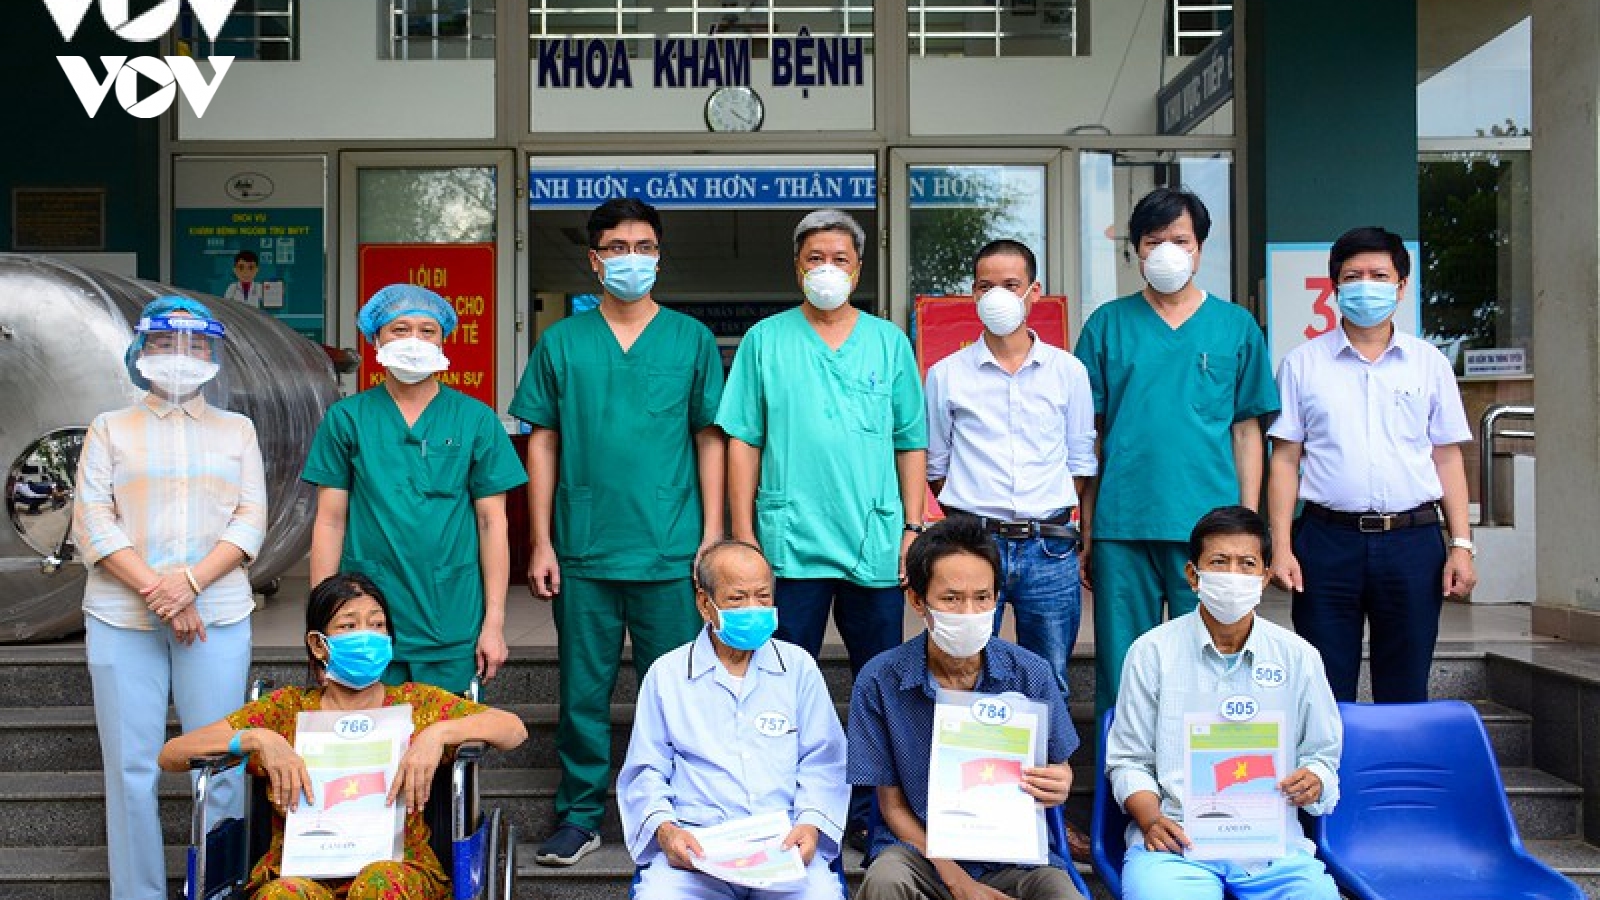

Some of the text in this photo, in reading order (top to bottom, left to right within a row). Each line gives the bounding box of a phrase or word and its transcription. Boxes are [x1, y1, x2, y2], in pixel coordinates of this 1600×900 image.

[538, 24, 864, 98] KHOA KHÁM BỆNH
[576, 174, 629, 199] HƠN
[704, 173, 757, 198] HƠN
[774, 171, 843, 198] THÂN
[434, 267, 447, 288] ĐI
[456, 295, 485, 316] CHO
[462, 320, 479, 344] TẾ
[463, 371, 485, 389] SỰ
[1255, 667, 1283, 683] 505
[978, 703, 1007, 720] 784
[1226, 701, 1255, 716] 505
[339, 719, 369, 733] 766
[760, 717, 786, 731] 757
